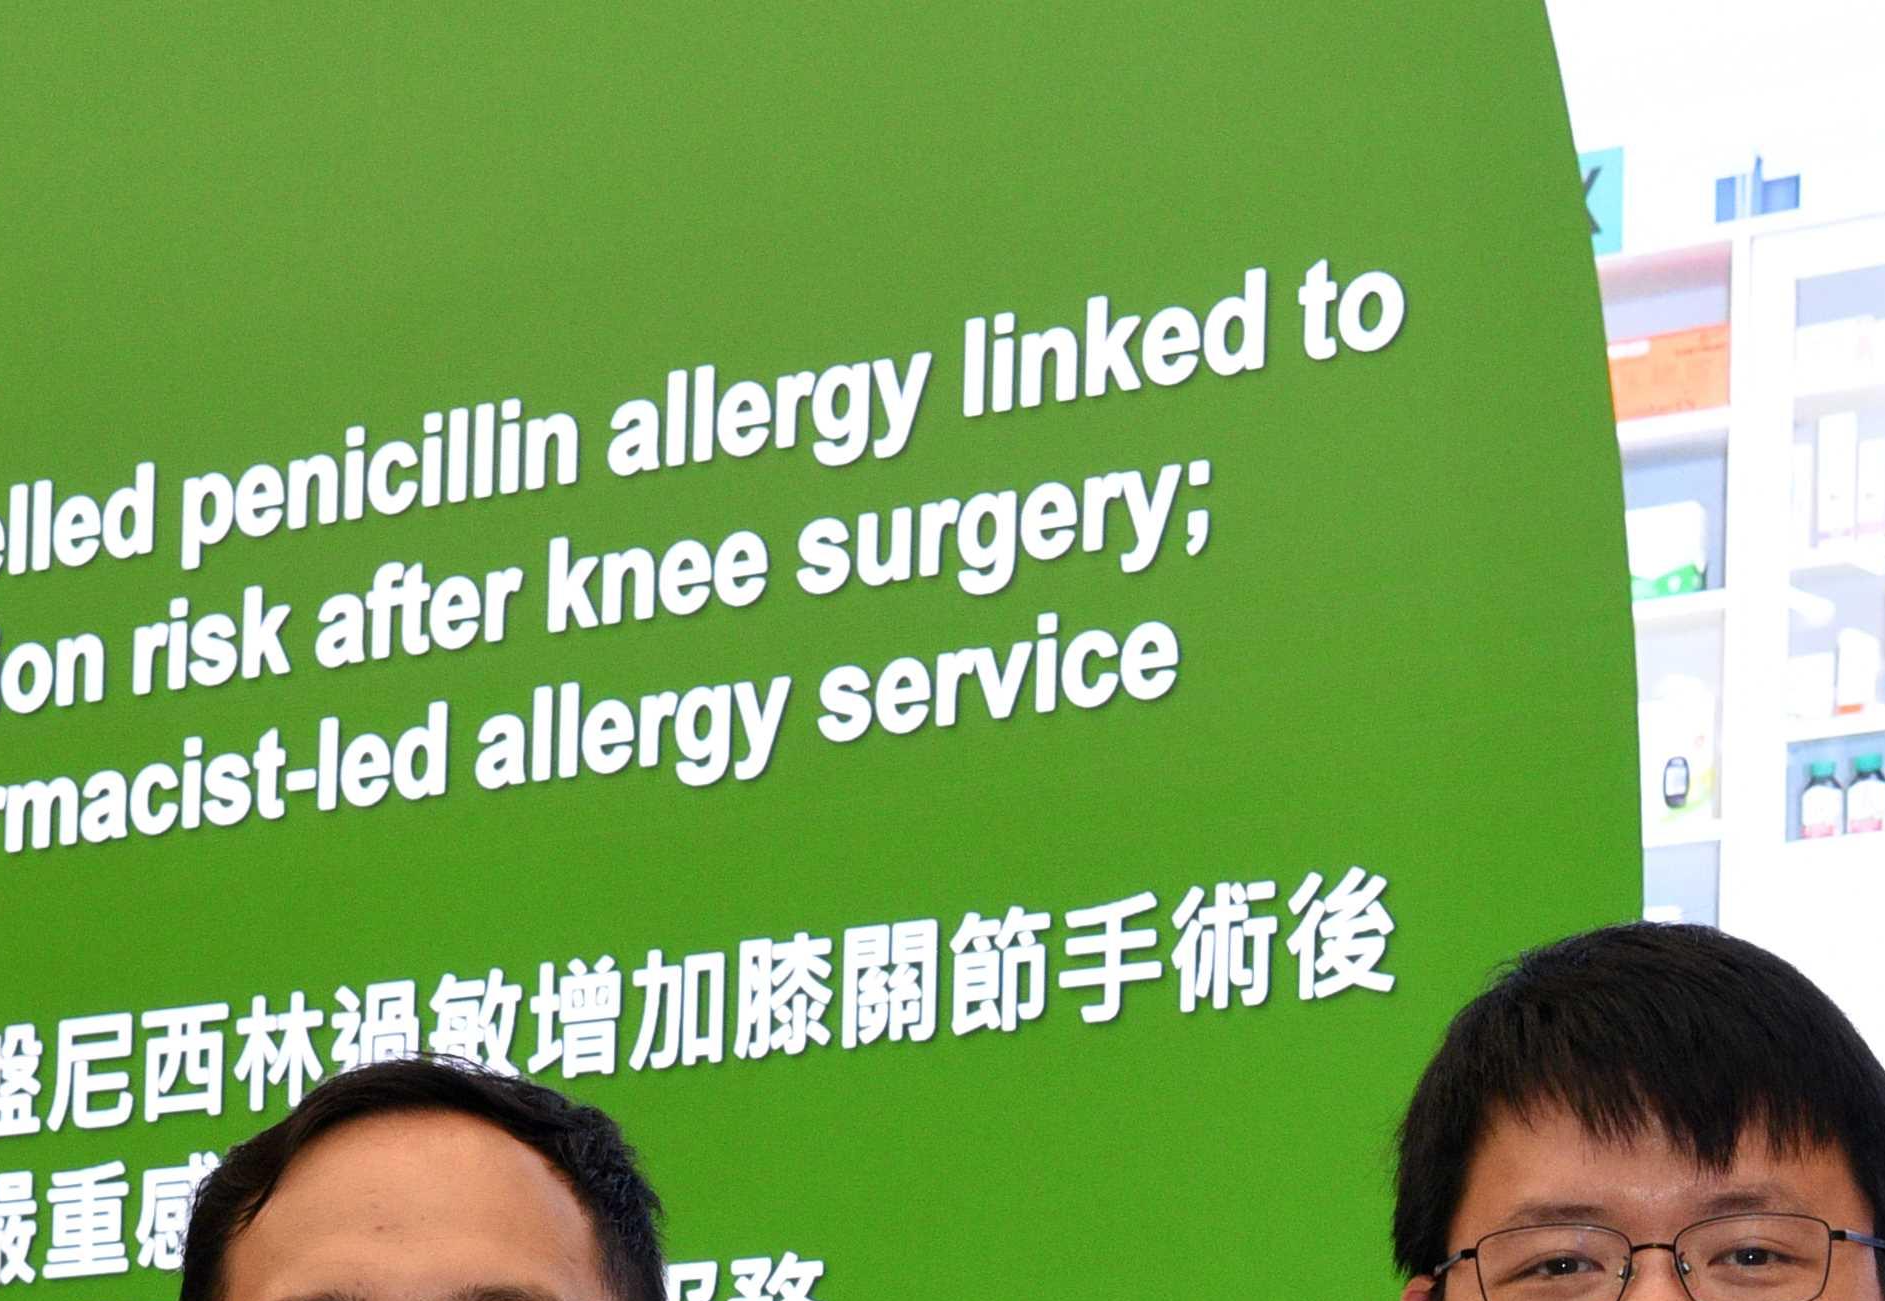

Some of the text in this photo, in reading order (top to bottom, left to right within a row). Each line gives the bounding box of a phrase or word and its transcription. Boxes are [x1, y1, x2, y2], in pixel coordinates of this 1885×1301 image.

[181, 398, 578, 570] penicillin
[607, 351, 932, 476] allergy
[963, 267, 1266, 417] linked
[1298, 258, 1404, 360] to
[132, 585, 291, 690] risk
[315, 562, 523, 668] after
[547, 531, 768, 633] knee
[796, 459, 1210, 595] surgery;
[475, 676, 791, 789] allergy
[817, 612, 1178, 742] service
